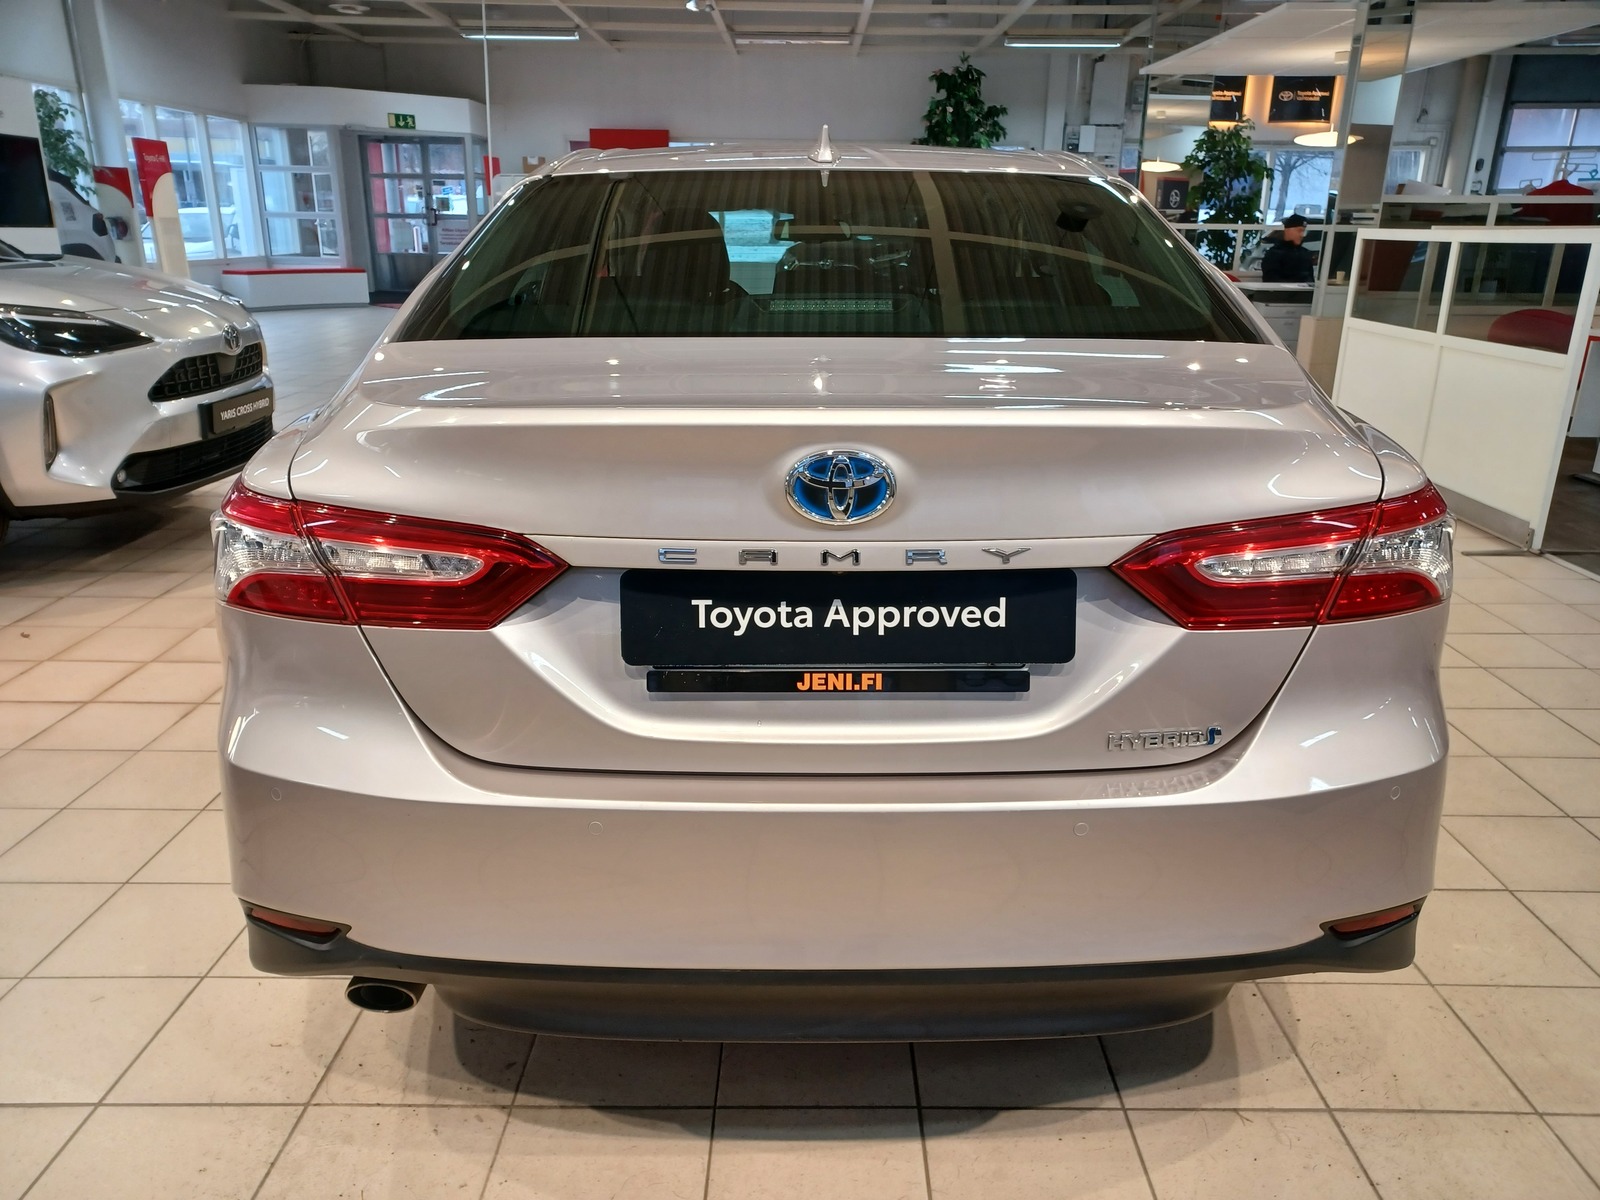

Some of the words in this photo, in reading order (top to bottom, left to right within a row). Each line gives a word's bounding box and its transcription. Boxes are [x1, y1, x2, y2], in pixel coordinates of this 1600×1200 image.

[221, 408, 236, 420] YARIS
[237, 403, 252, 416] CROSS
[253, 398, 269, 410] HYBRID
[657, 546, 1032, 566] CAMRY
[691, 599, 813, 636] Toyota
[824, 597, 1007, 636] Approved
[796, 672, 883, 691] JENI.FI
[1107, 730, 1205, 751] HYBRID
